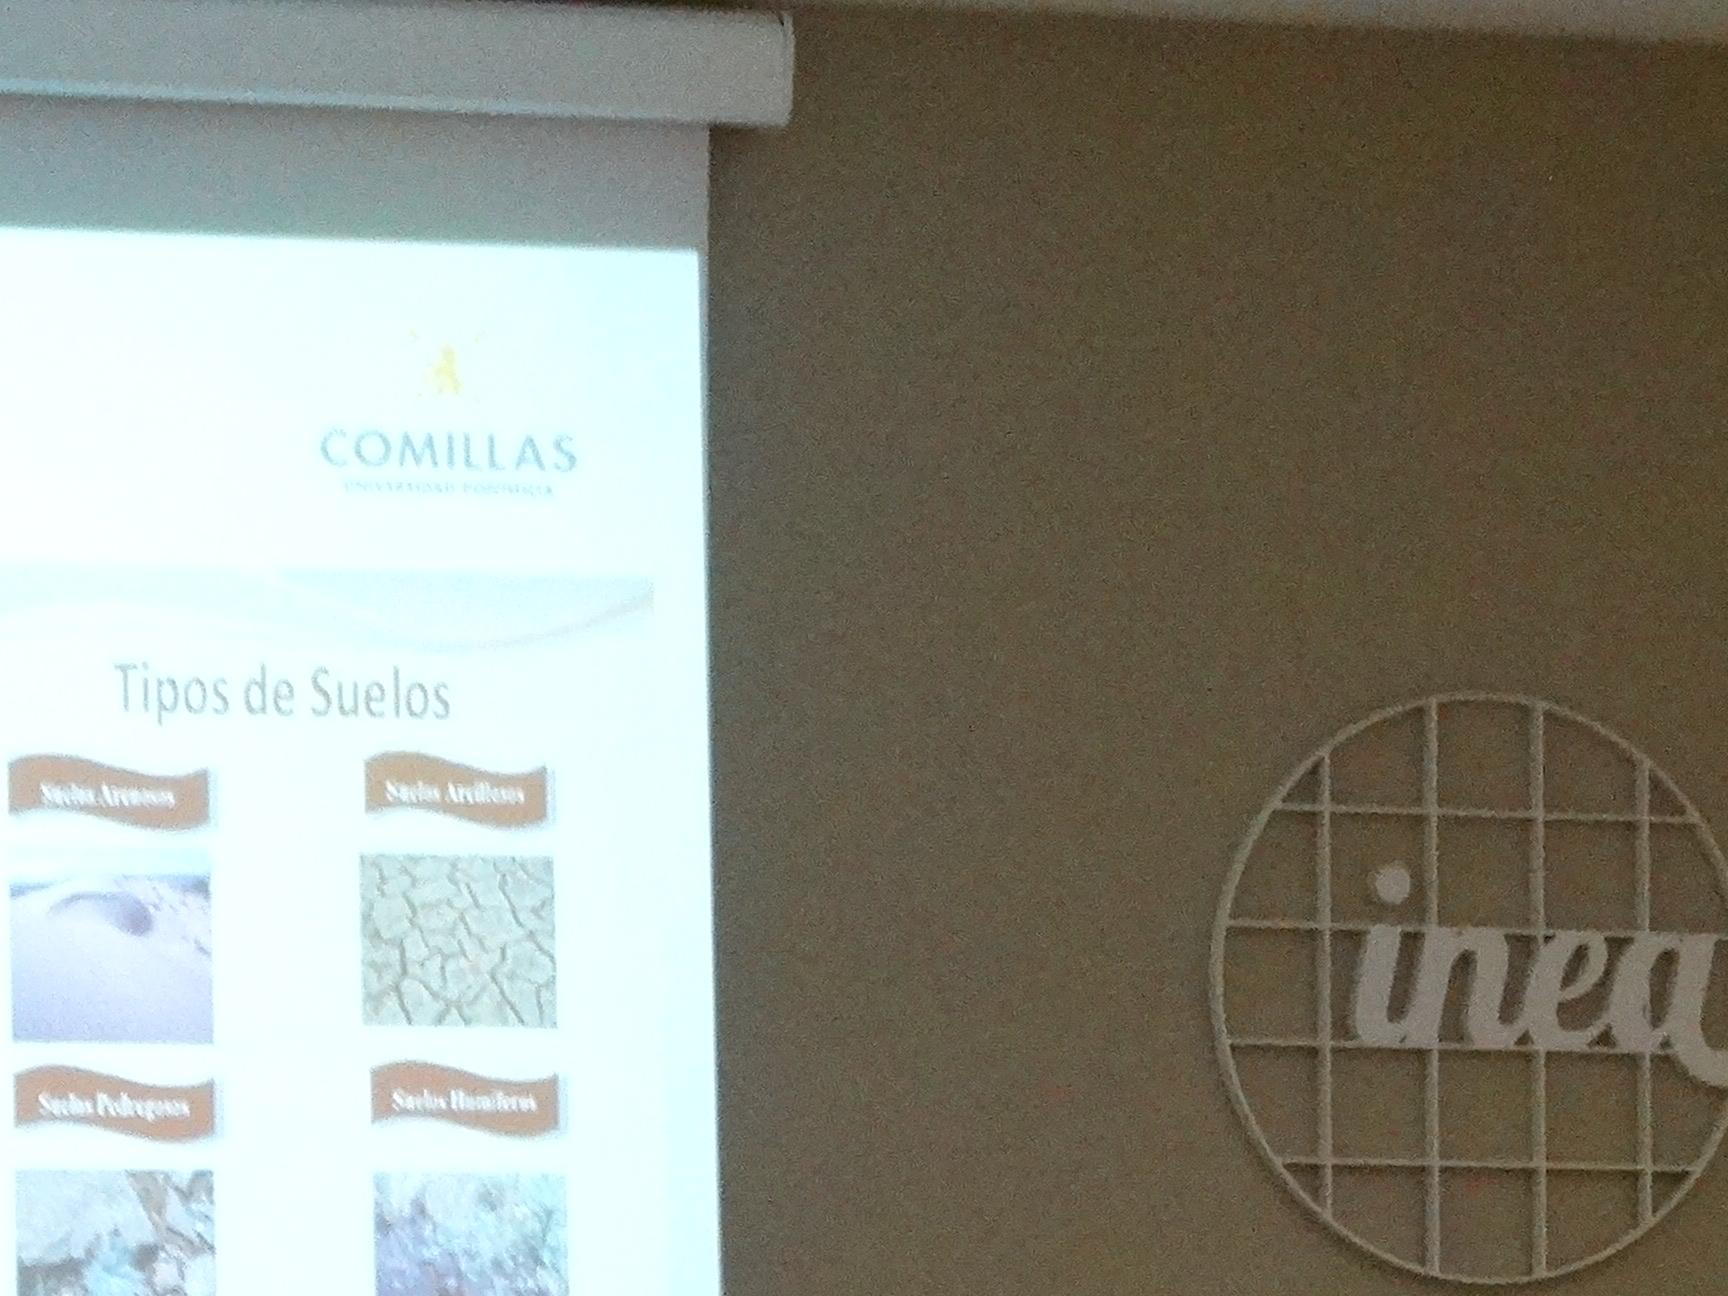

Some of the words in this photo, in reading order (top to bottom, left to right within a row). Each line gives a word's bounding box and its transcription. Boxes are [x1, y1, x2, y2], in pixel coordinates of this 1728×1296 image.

[318, 427, 578, 474] COMILLAS
[113, 661, 230, 727] Tipos
[243, 663, 295, 718] de
[310, 665, 451, 721] Suelos
